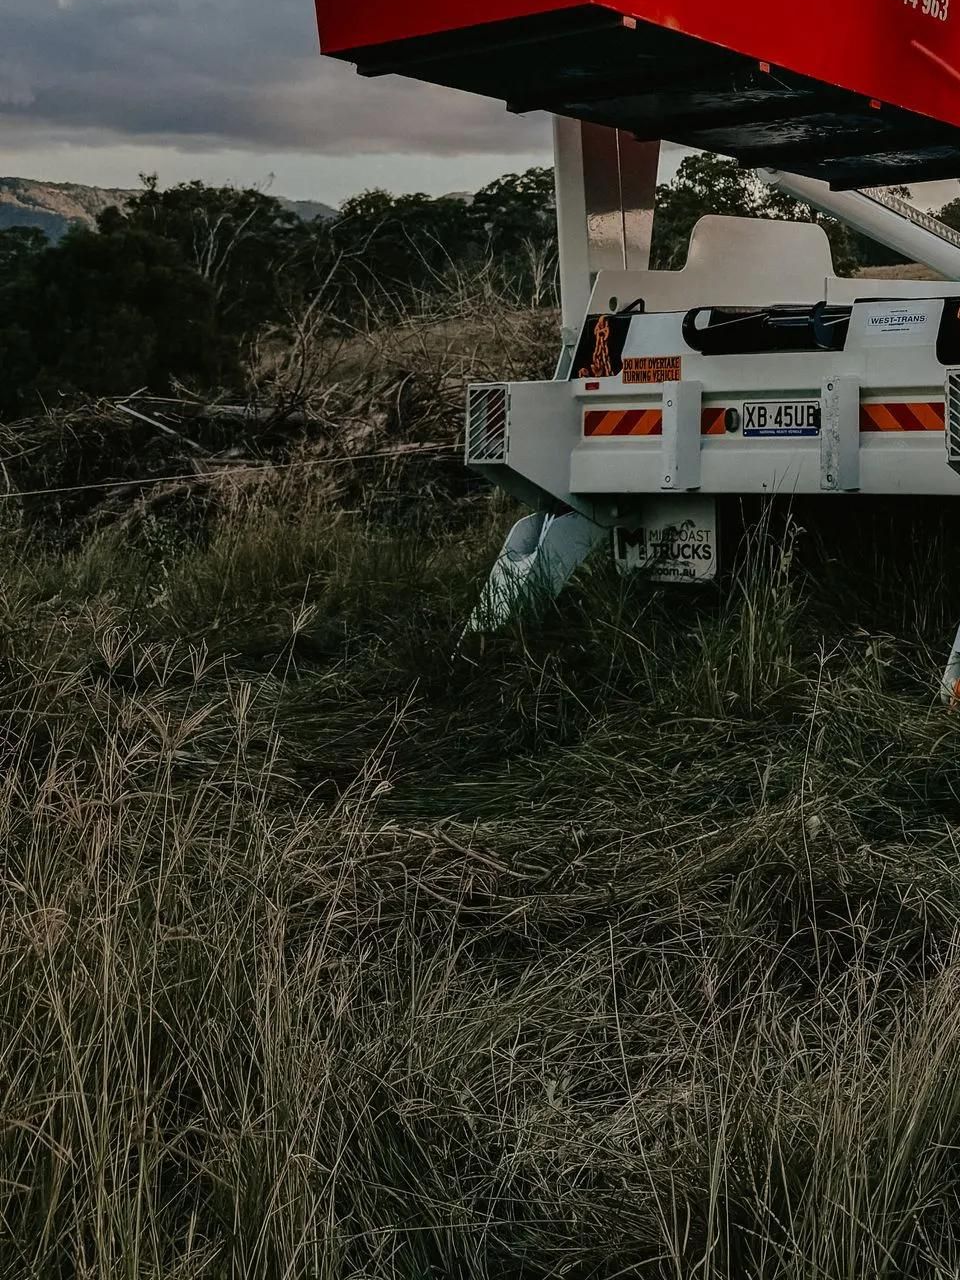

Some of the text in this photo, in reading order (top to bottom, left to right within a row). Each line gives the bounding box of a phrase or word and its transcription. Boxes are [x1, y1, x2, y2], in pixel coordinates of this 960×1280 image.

[871, 315, 926, 325] WEST-TRANS
[624, 358, 680, 370] DO NOT OVERTAKE
[623, 370, 680, 382] TURNING VEHICLE
[650, 543, 712, 560] TRUCKS
